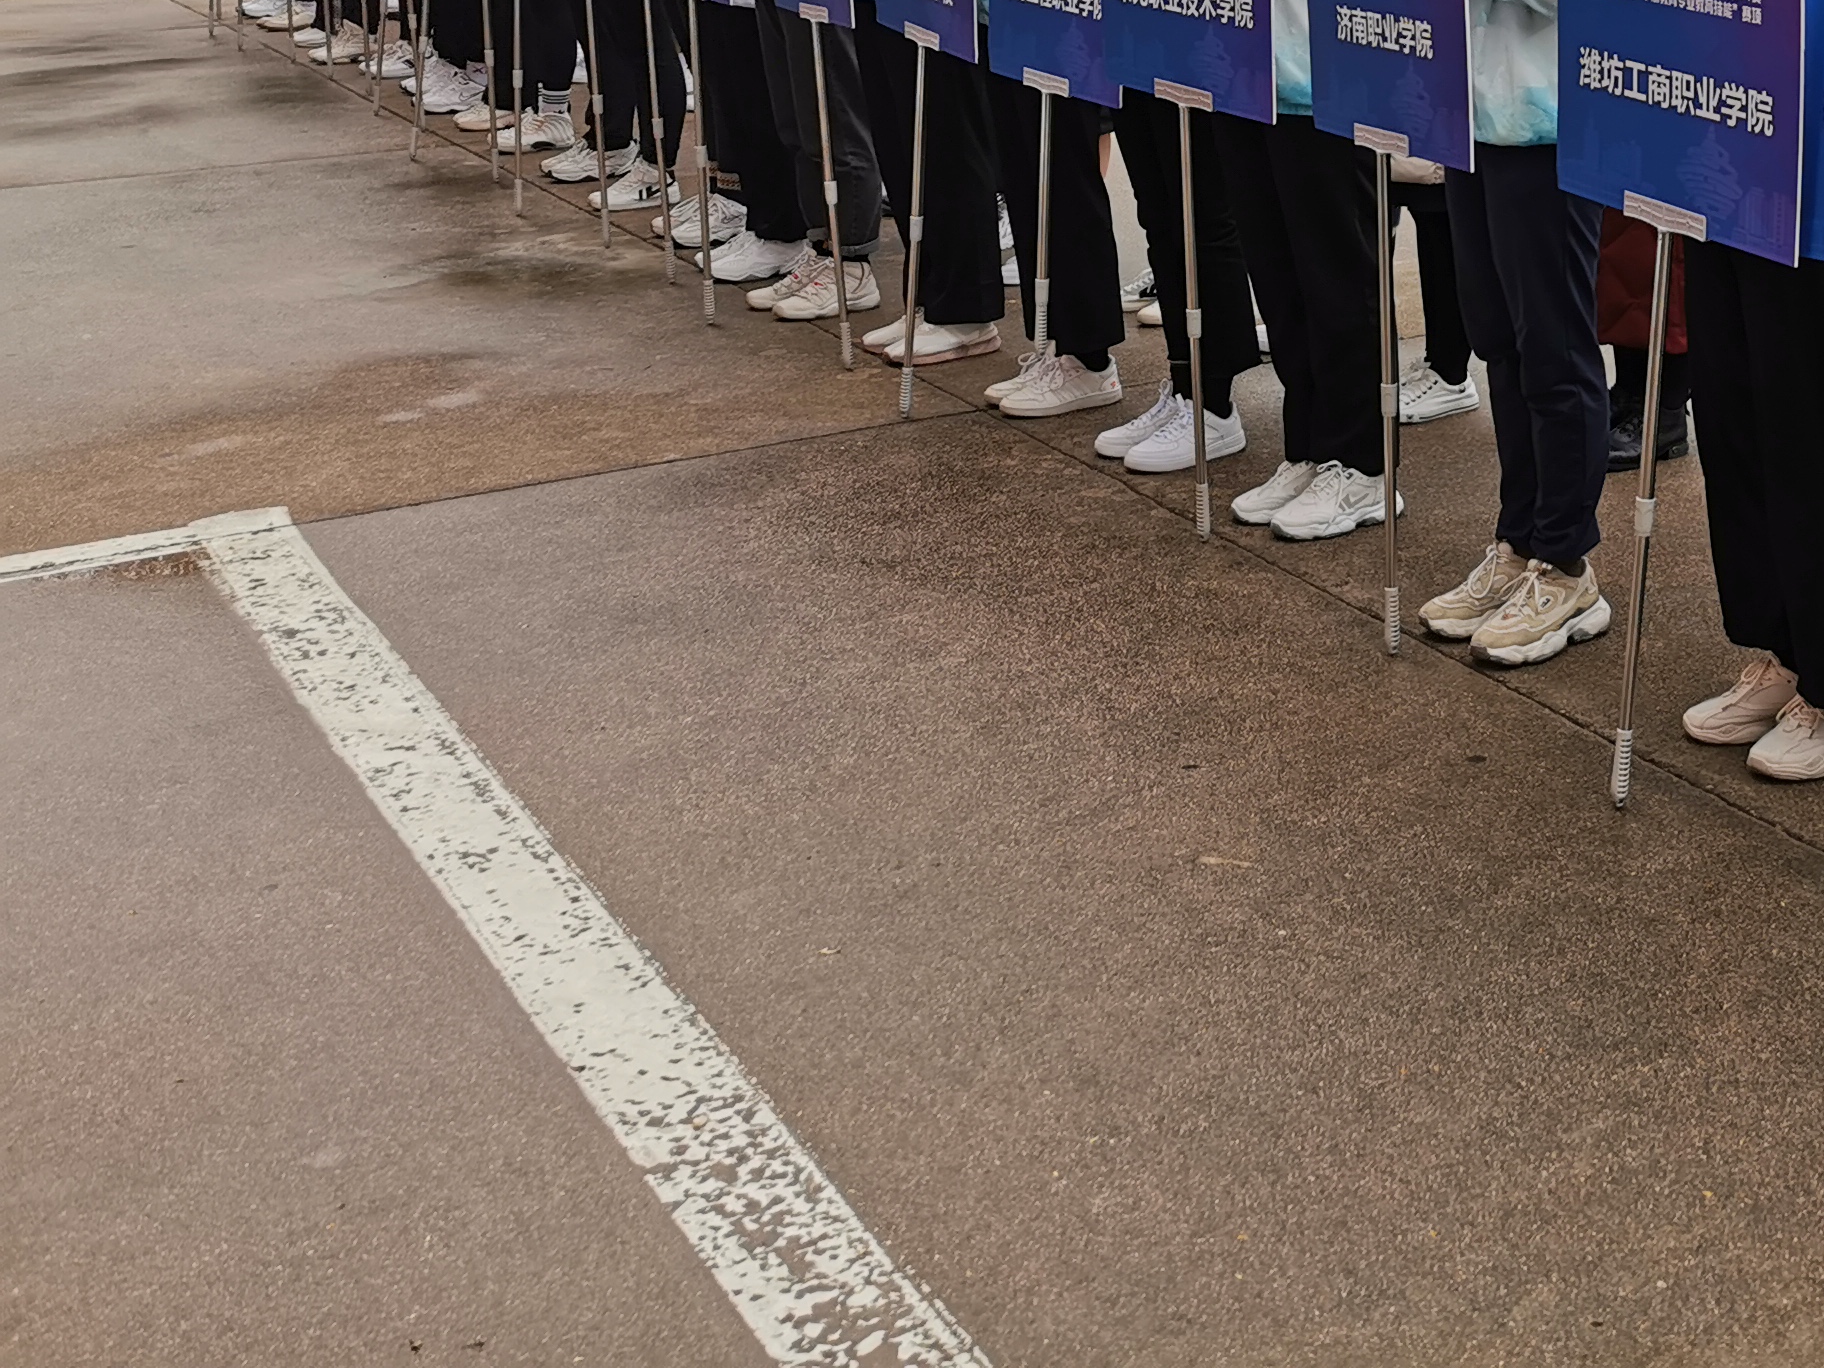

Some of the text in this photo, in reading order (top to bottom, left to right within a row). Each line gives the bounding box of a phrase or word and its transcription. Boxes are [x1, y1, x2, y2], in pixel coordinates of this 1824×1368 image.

[1335, 4, 1434, 60] 济南职业学院
[1578, 45, 1775, 138] 潍坊工商职业学院
